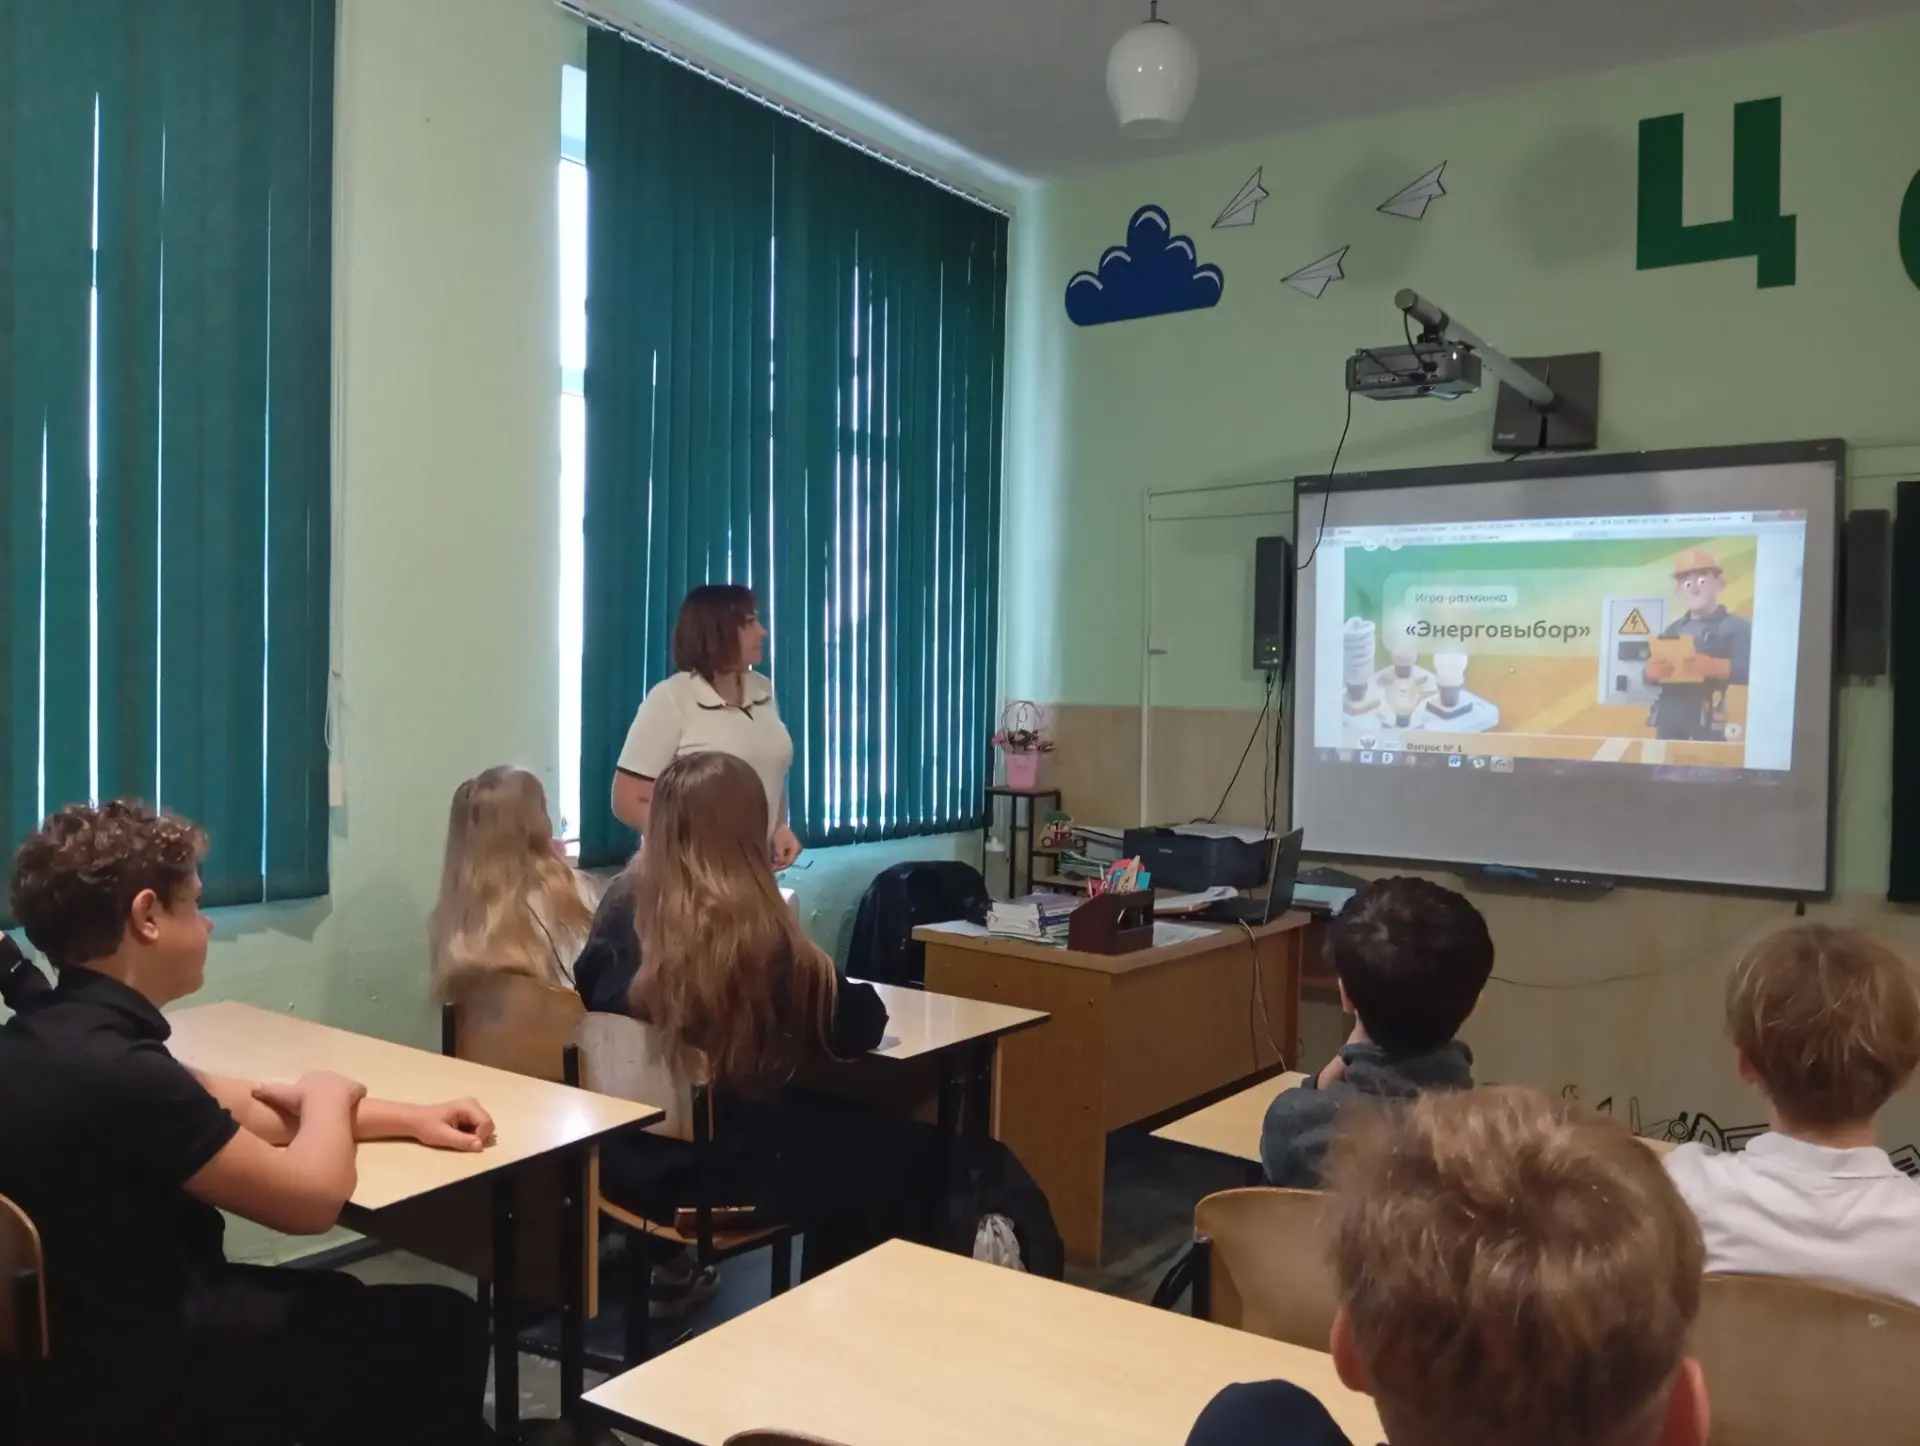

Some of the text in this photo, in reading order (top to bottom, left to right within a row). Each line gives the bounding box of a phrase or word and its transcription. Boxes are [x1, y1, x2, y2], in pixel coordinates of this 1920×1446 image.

[1636, 96, 1920, 291] Ц
[1405, 619, 1591, 643] «Энерговыбор»
[1457, 744, 1463, 753] 1
